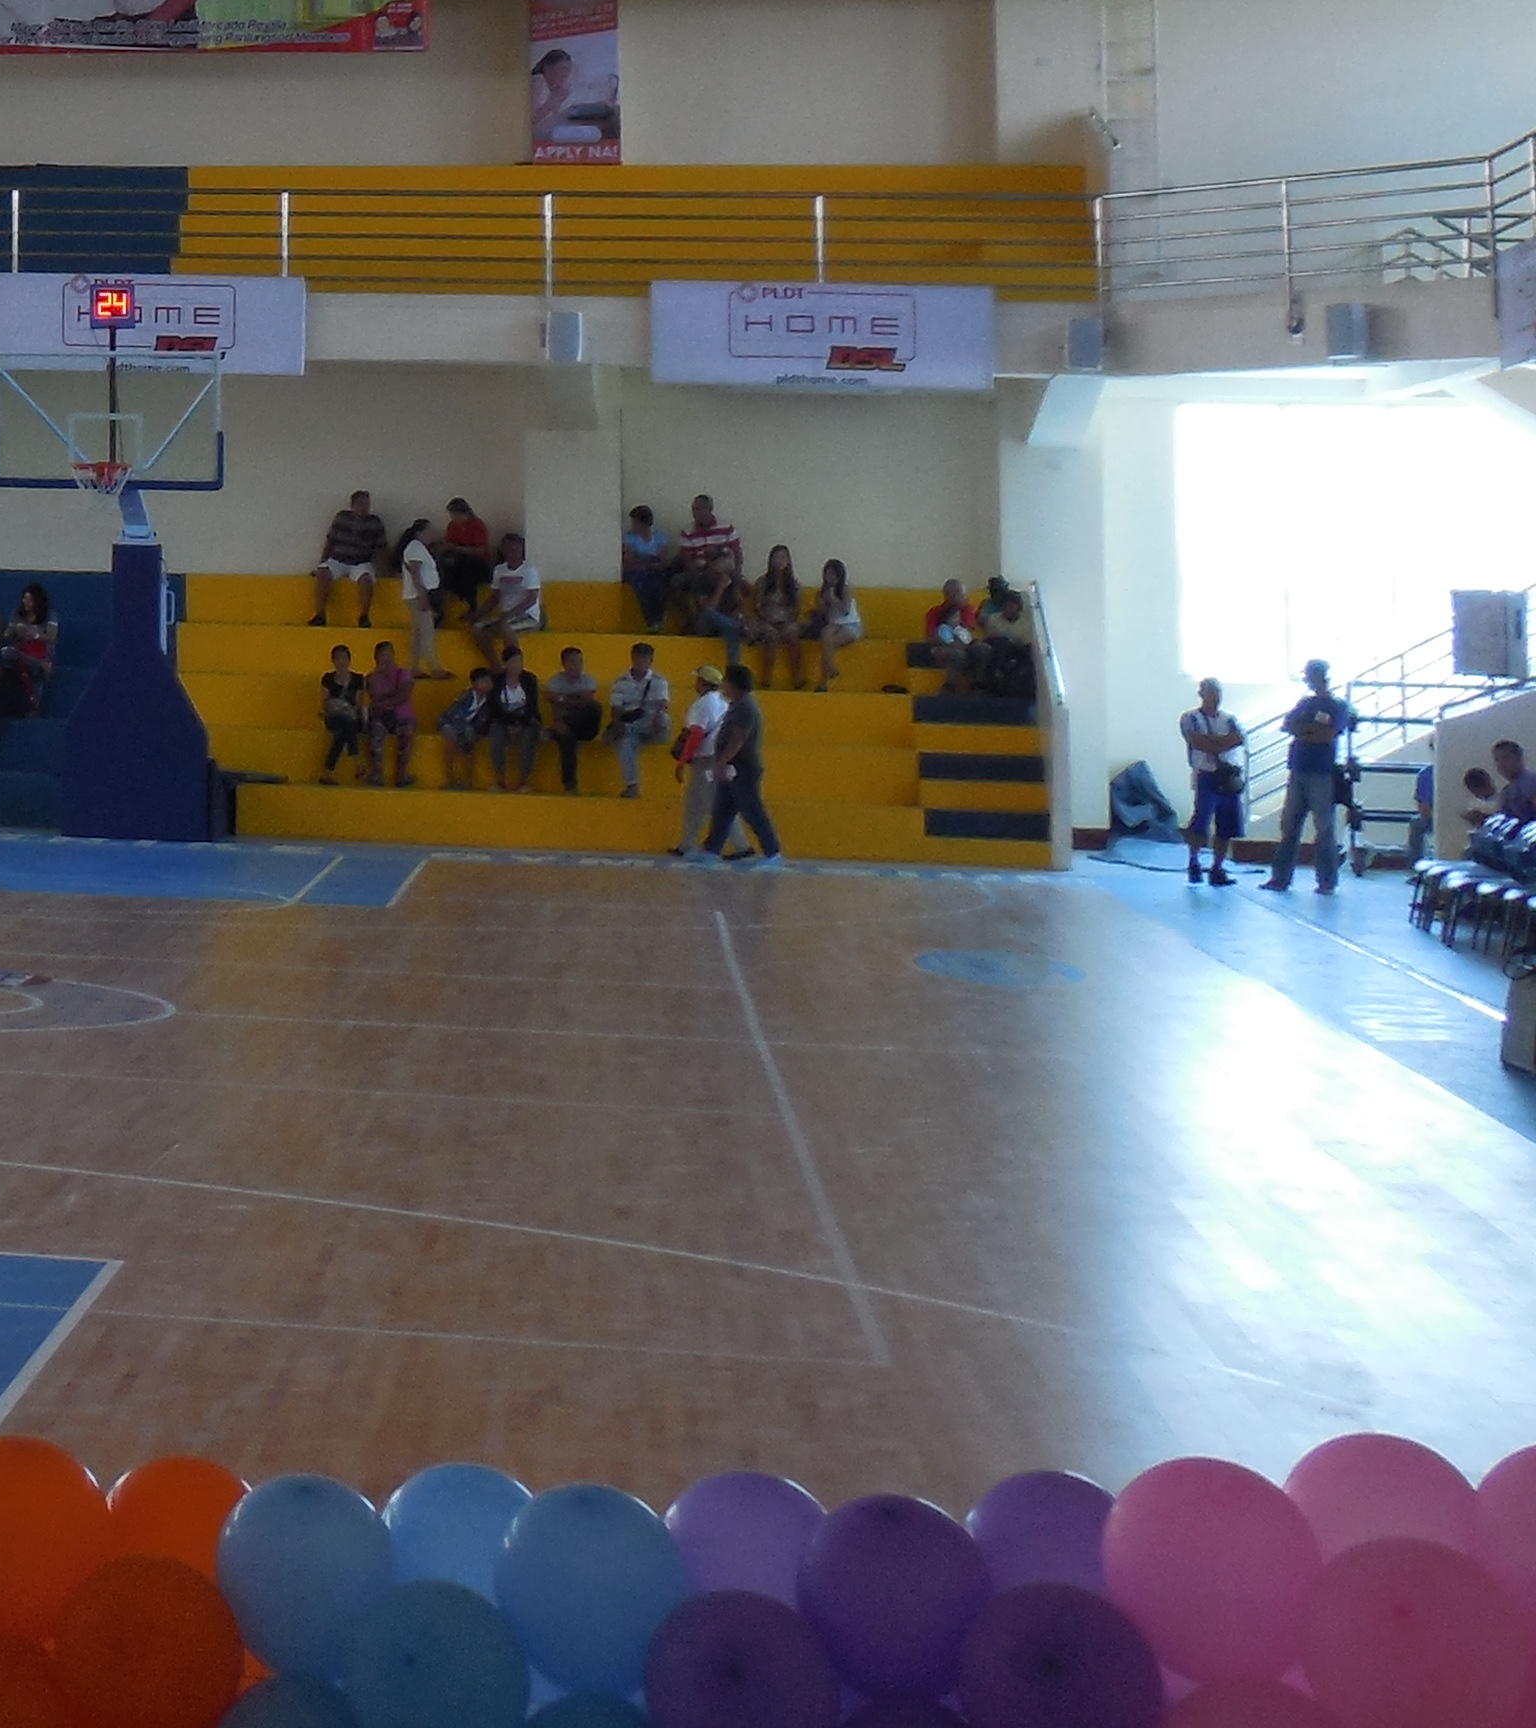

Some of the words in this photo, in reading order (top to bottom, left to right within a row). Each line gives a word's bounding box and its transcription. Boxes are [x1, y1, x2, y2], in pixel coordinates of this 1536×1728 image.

[535, 145, 584, 160] APPLY
[762, 286, 805, 300] PLDT
[98, 292, 128, 317] 24
[745, 314, 900, 336] HOME
[826, 345, 907, 373] DSL
[775, 373, 869, 388] pldthome.com
